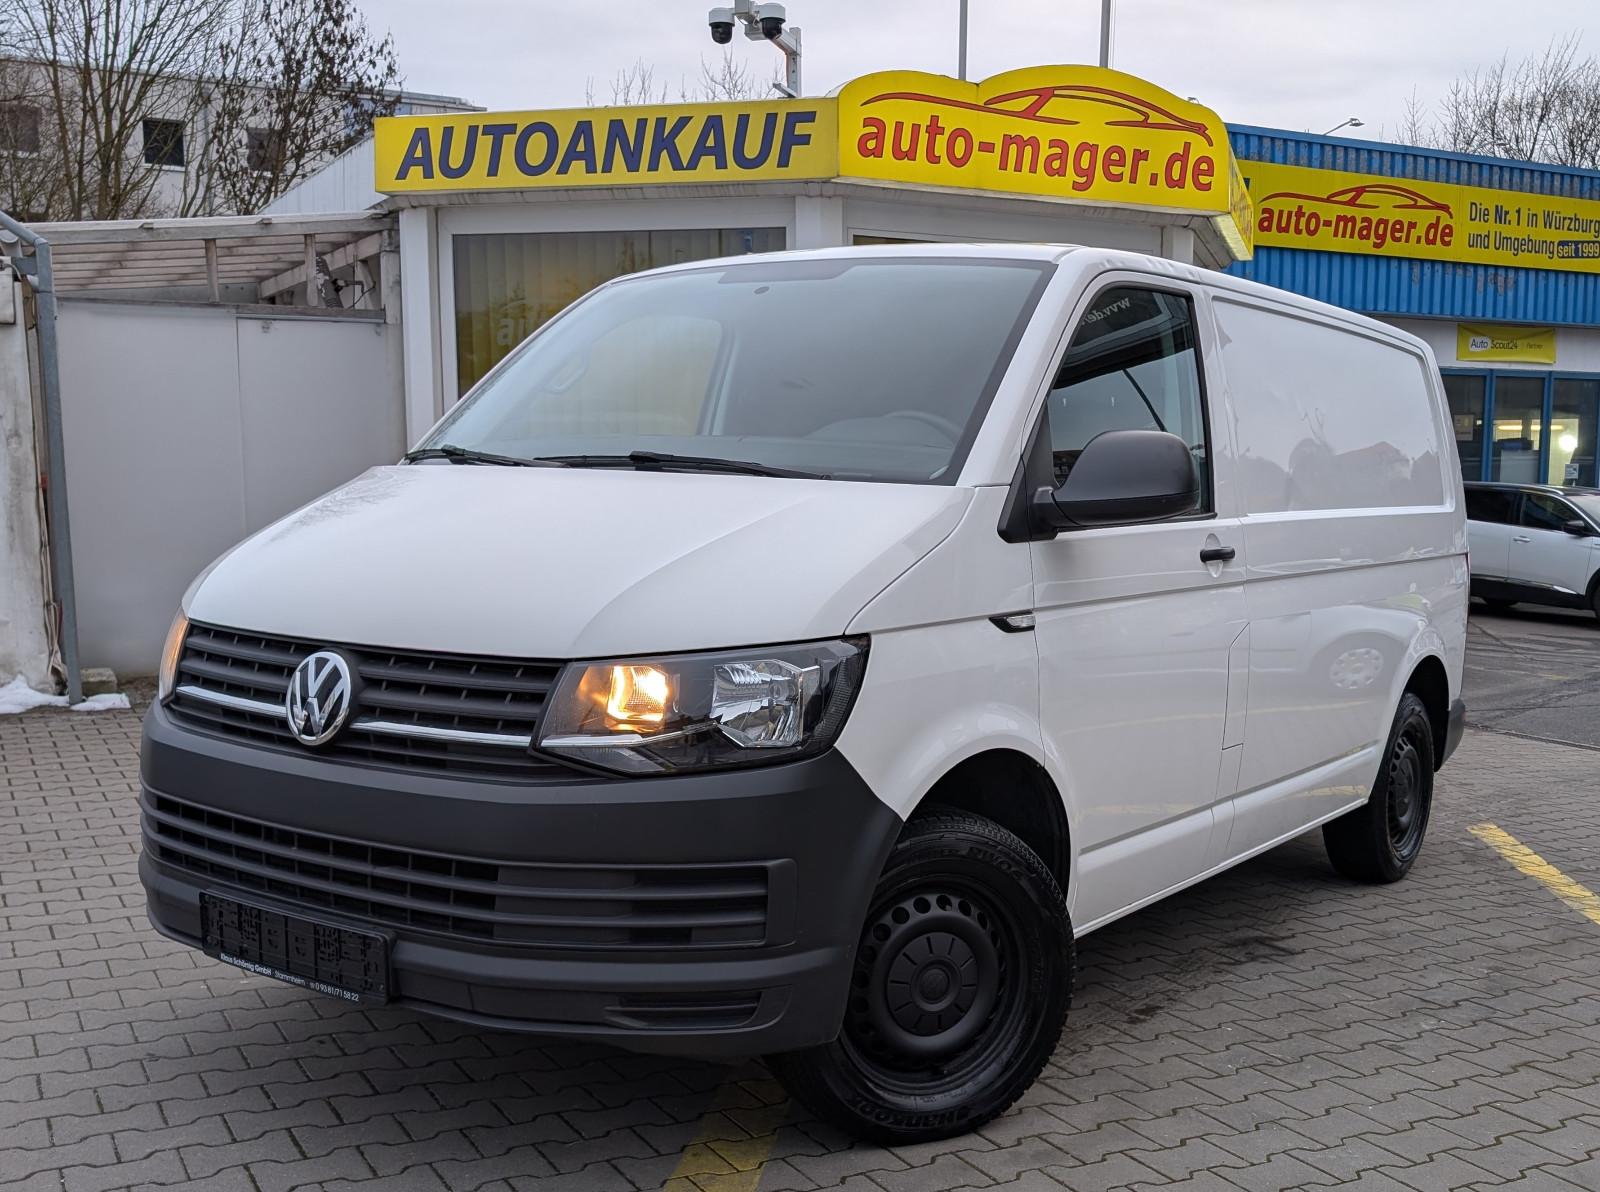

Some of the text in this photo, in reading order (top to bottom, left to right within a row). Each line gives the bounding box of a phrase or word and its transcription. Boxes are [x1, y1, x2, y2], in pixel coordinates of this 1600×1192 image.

[394, 110, 818, 181] AUTOANKAUF
[857, 114, 1216, 193] auto-mager.de
[1257, 204, 1455, 250] auto-mager.de
[1469, 201, 1600, 239] Die Nr. 1 in Würzburg
[1468, 230, 1600, 260] und Umgebung seit 1999
[1470, 338, 1489, 349] Auto
[255, 964, 272, 976] GmbH
